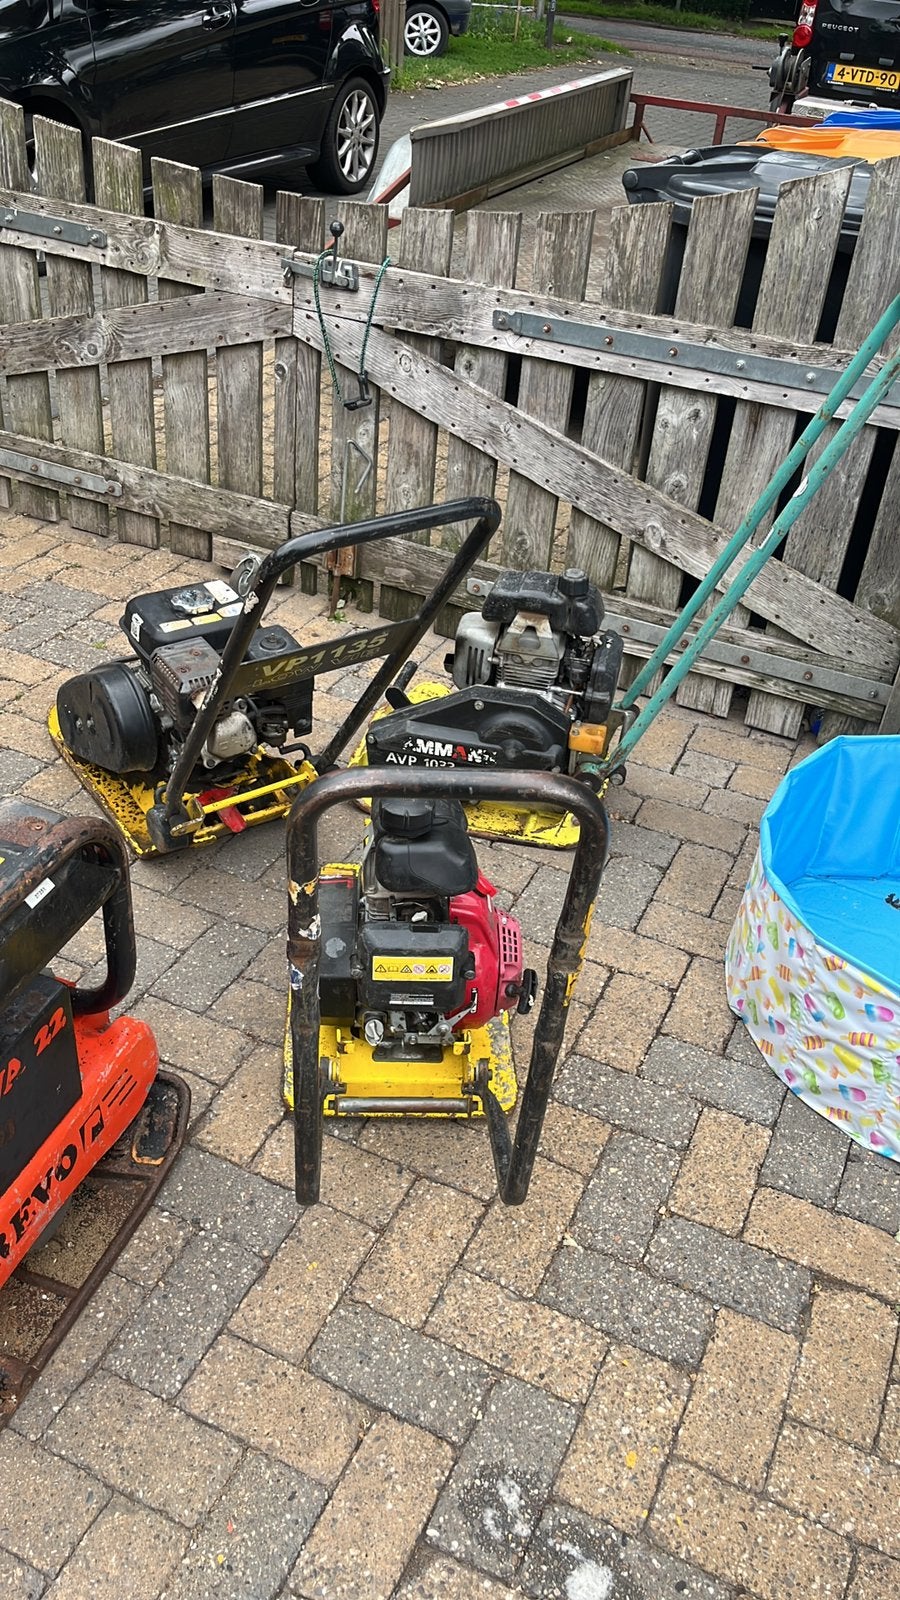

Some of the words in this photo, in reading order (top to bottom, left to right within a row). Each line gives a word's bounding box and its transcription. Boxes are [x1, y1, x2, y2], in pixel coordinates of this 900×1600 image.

[822, 22, 859, 33] PEUGEOT
[837, 67, 897, 87] 4-VTD-90
[262, 632, 389, 677] VP1135
[385, 752, 417, 766] AVP
[33, 1007, 67, 1057] 22
